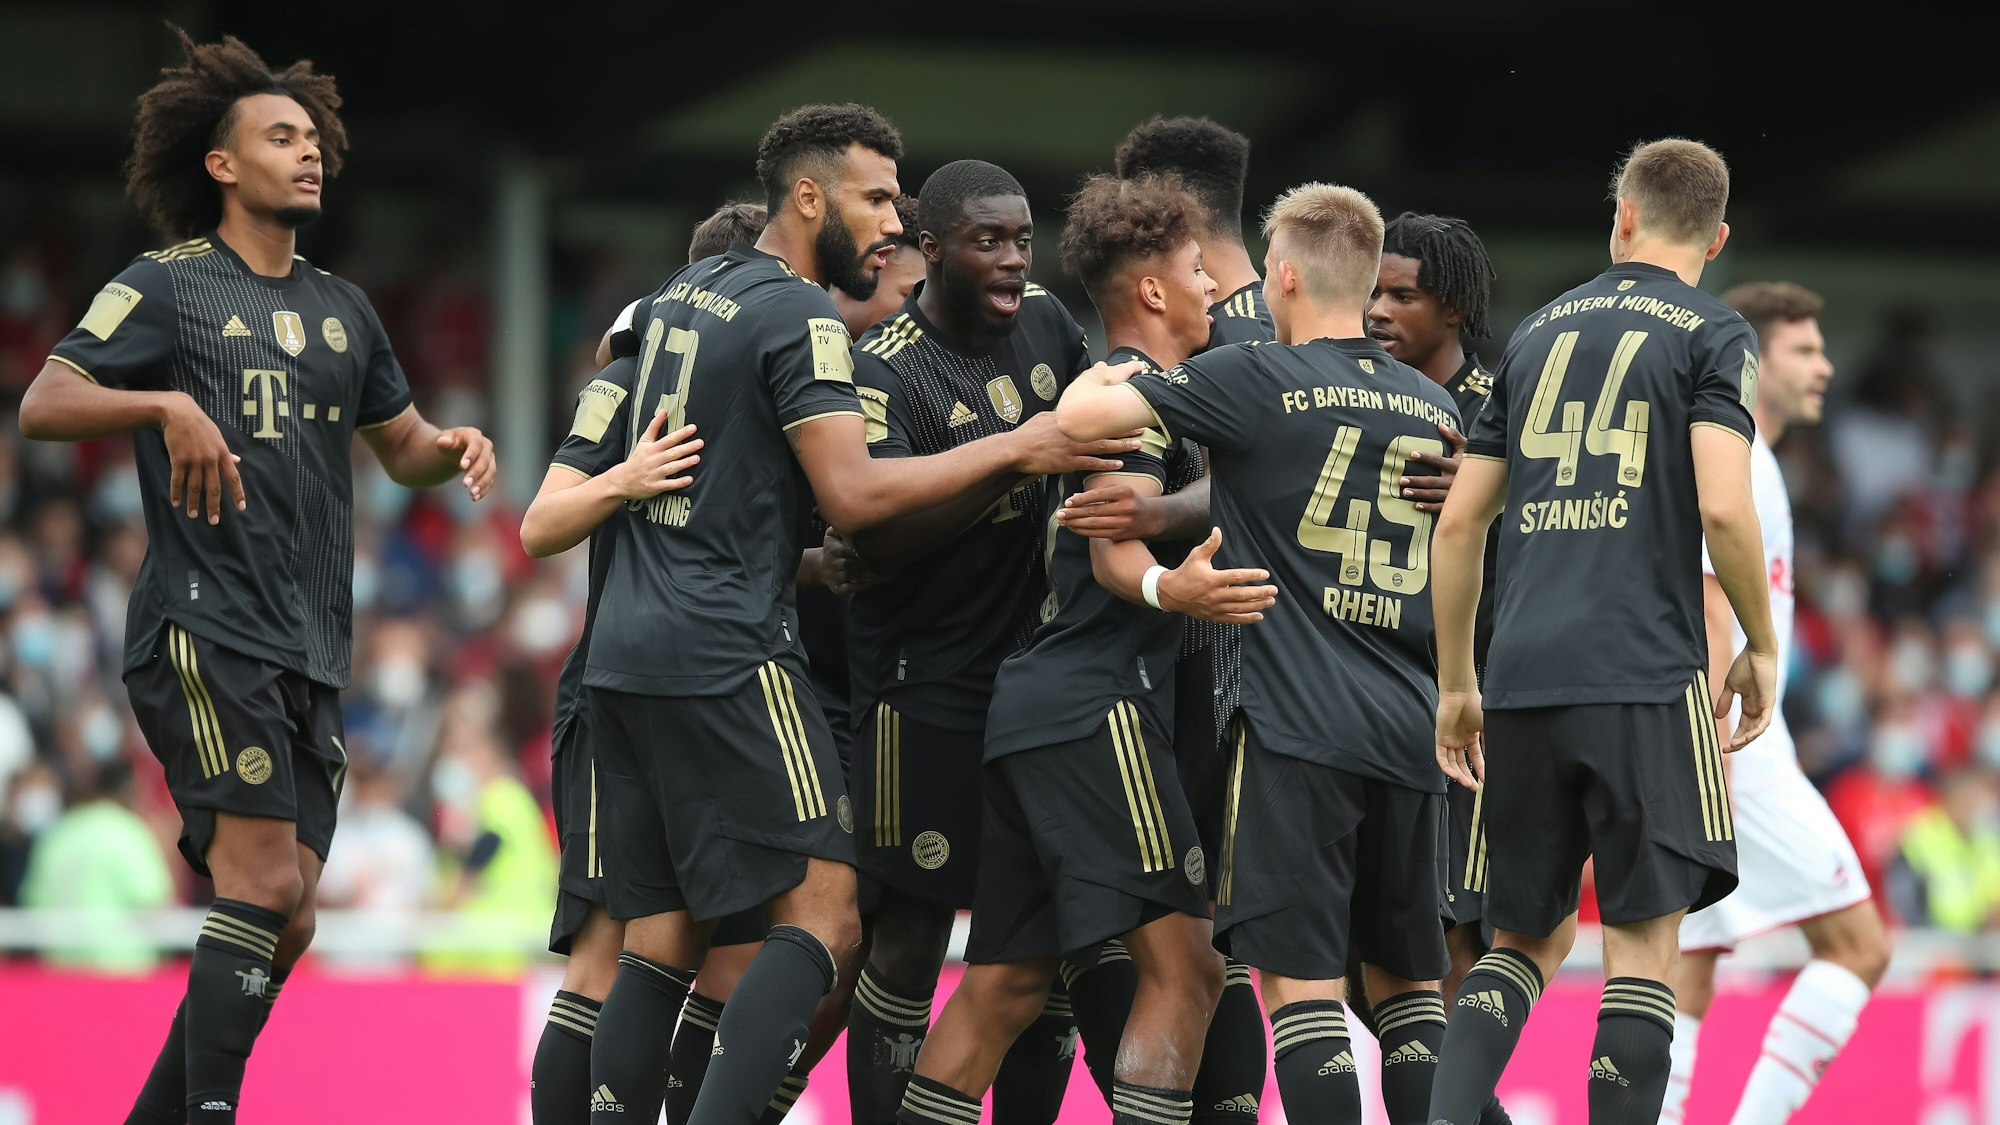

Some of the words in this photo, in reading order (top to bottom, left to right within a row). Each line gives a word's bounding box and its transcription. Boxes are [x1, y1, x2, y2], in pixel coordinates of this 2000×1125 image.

[102, 286, 133, 303] AGENTA
[1550, 295, 1619, 321] BAYERN
[1618, 295, 1706, 332] MÜNCHEN
[815, 324, 852, 339] MAGEN
[818, 335, 830, 345] TV
[1281, 391, 1309, 414] FC
[1312, 385, 1384, 410] BAYERN
[1003, 404, 1017, 414] FIFA
[1519, 330, 1649, 488] 44
[949, 412, 978, 428] adidas
[1519, 489, 1629, 534] STANIŠIĆ
[1322, 586, 1402, 630] RHEIN
[1457, 997, 1509, 1028] adidas
[1384, 1053, 1439, 1067] adidas
[1317, 1063, 1357, 1077] adida
[1214, 1103, 1259, 1115] adida
